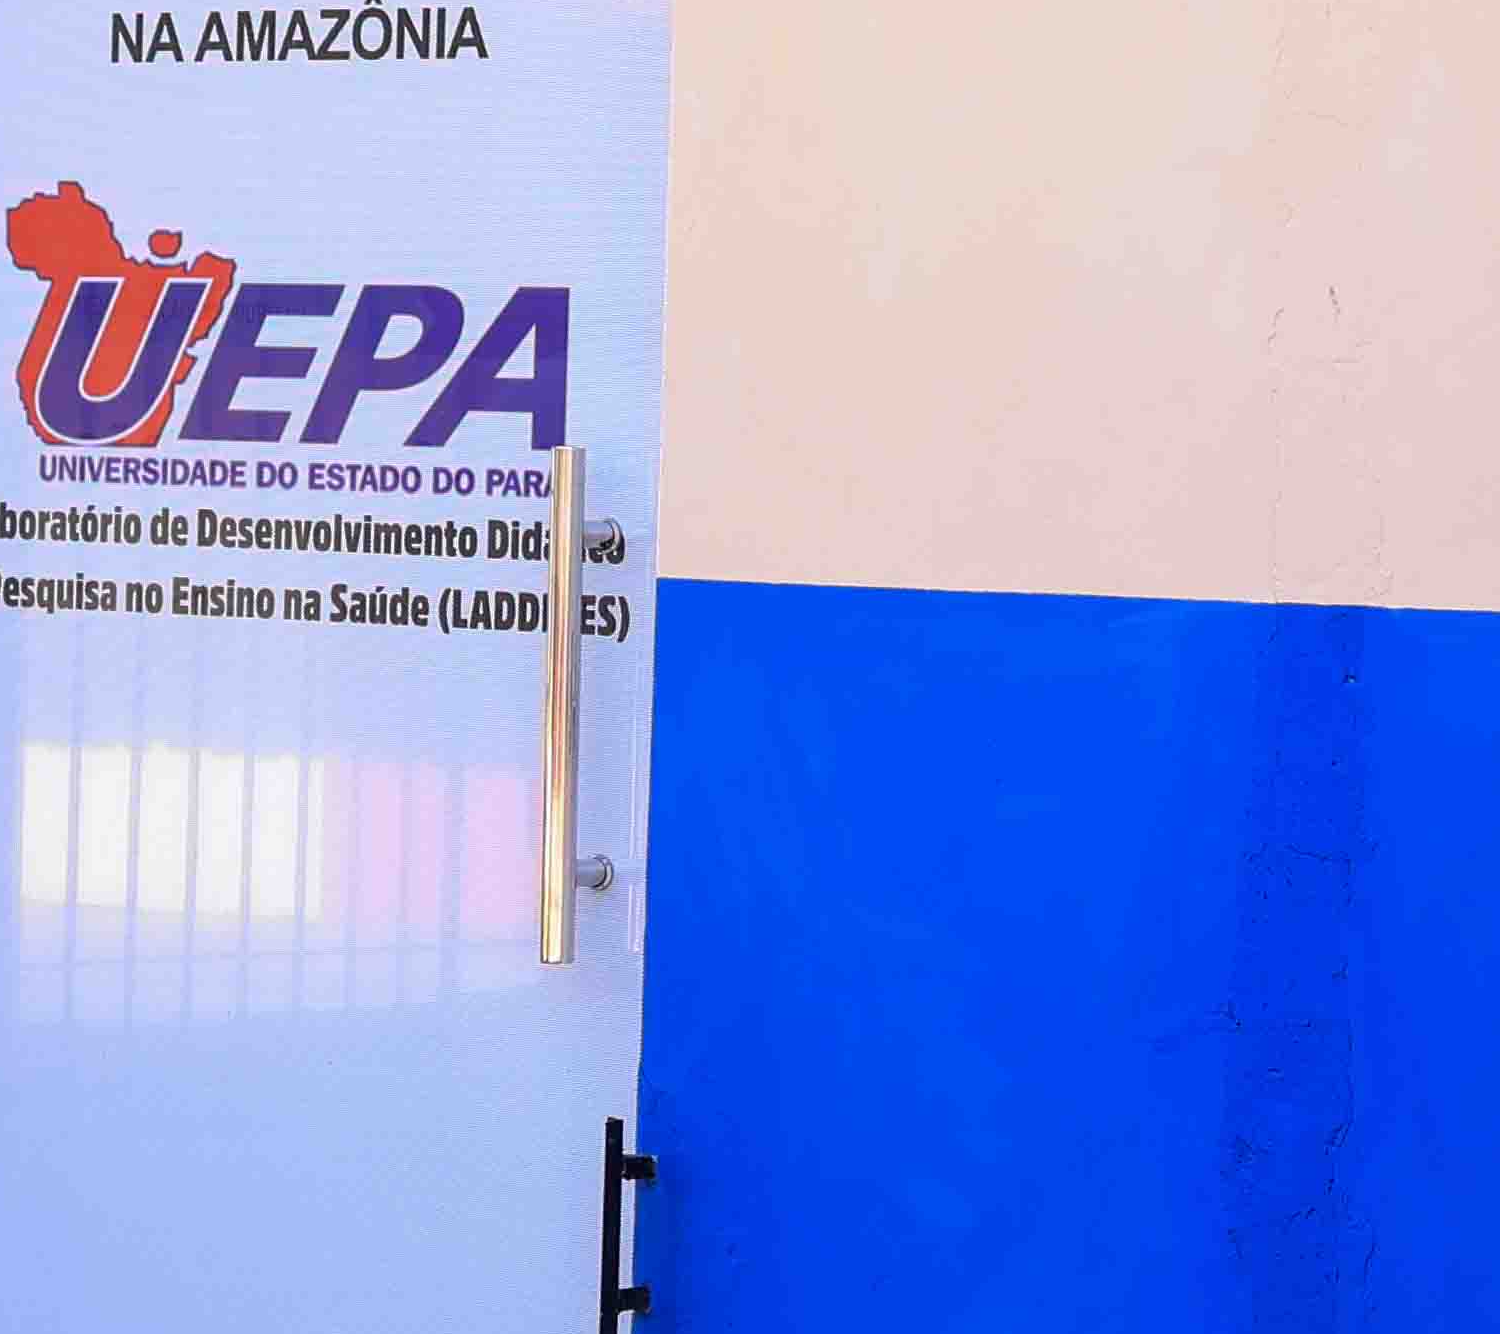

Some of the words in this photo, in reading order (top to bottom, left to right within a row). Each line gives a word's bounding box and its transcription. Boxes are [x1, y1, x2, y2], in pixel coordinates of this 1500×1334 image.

[111, 12, 184, 63] NA
[34, 279, 570, 448] UEPA
[40, 454, 247, 487] UNIVERSIDADE
[256, 462, 298, 490] DO
[307, 463, 421, 493] ESTADO
[432, 466, 475, 496] DO
[151, 508, 188, 546] de
[196, 508, 477, 558] Desenvolvimento
[125, 582, 163, 613] no
[172, 577, 274, 619] Ensino
[284, 589, 321, 620] na
[330, 584, 428, 626] Saúde
